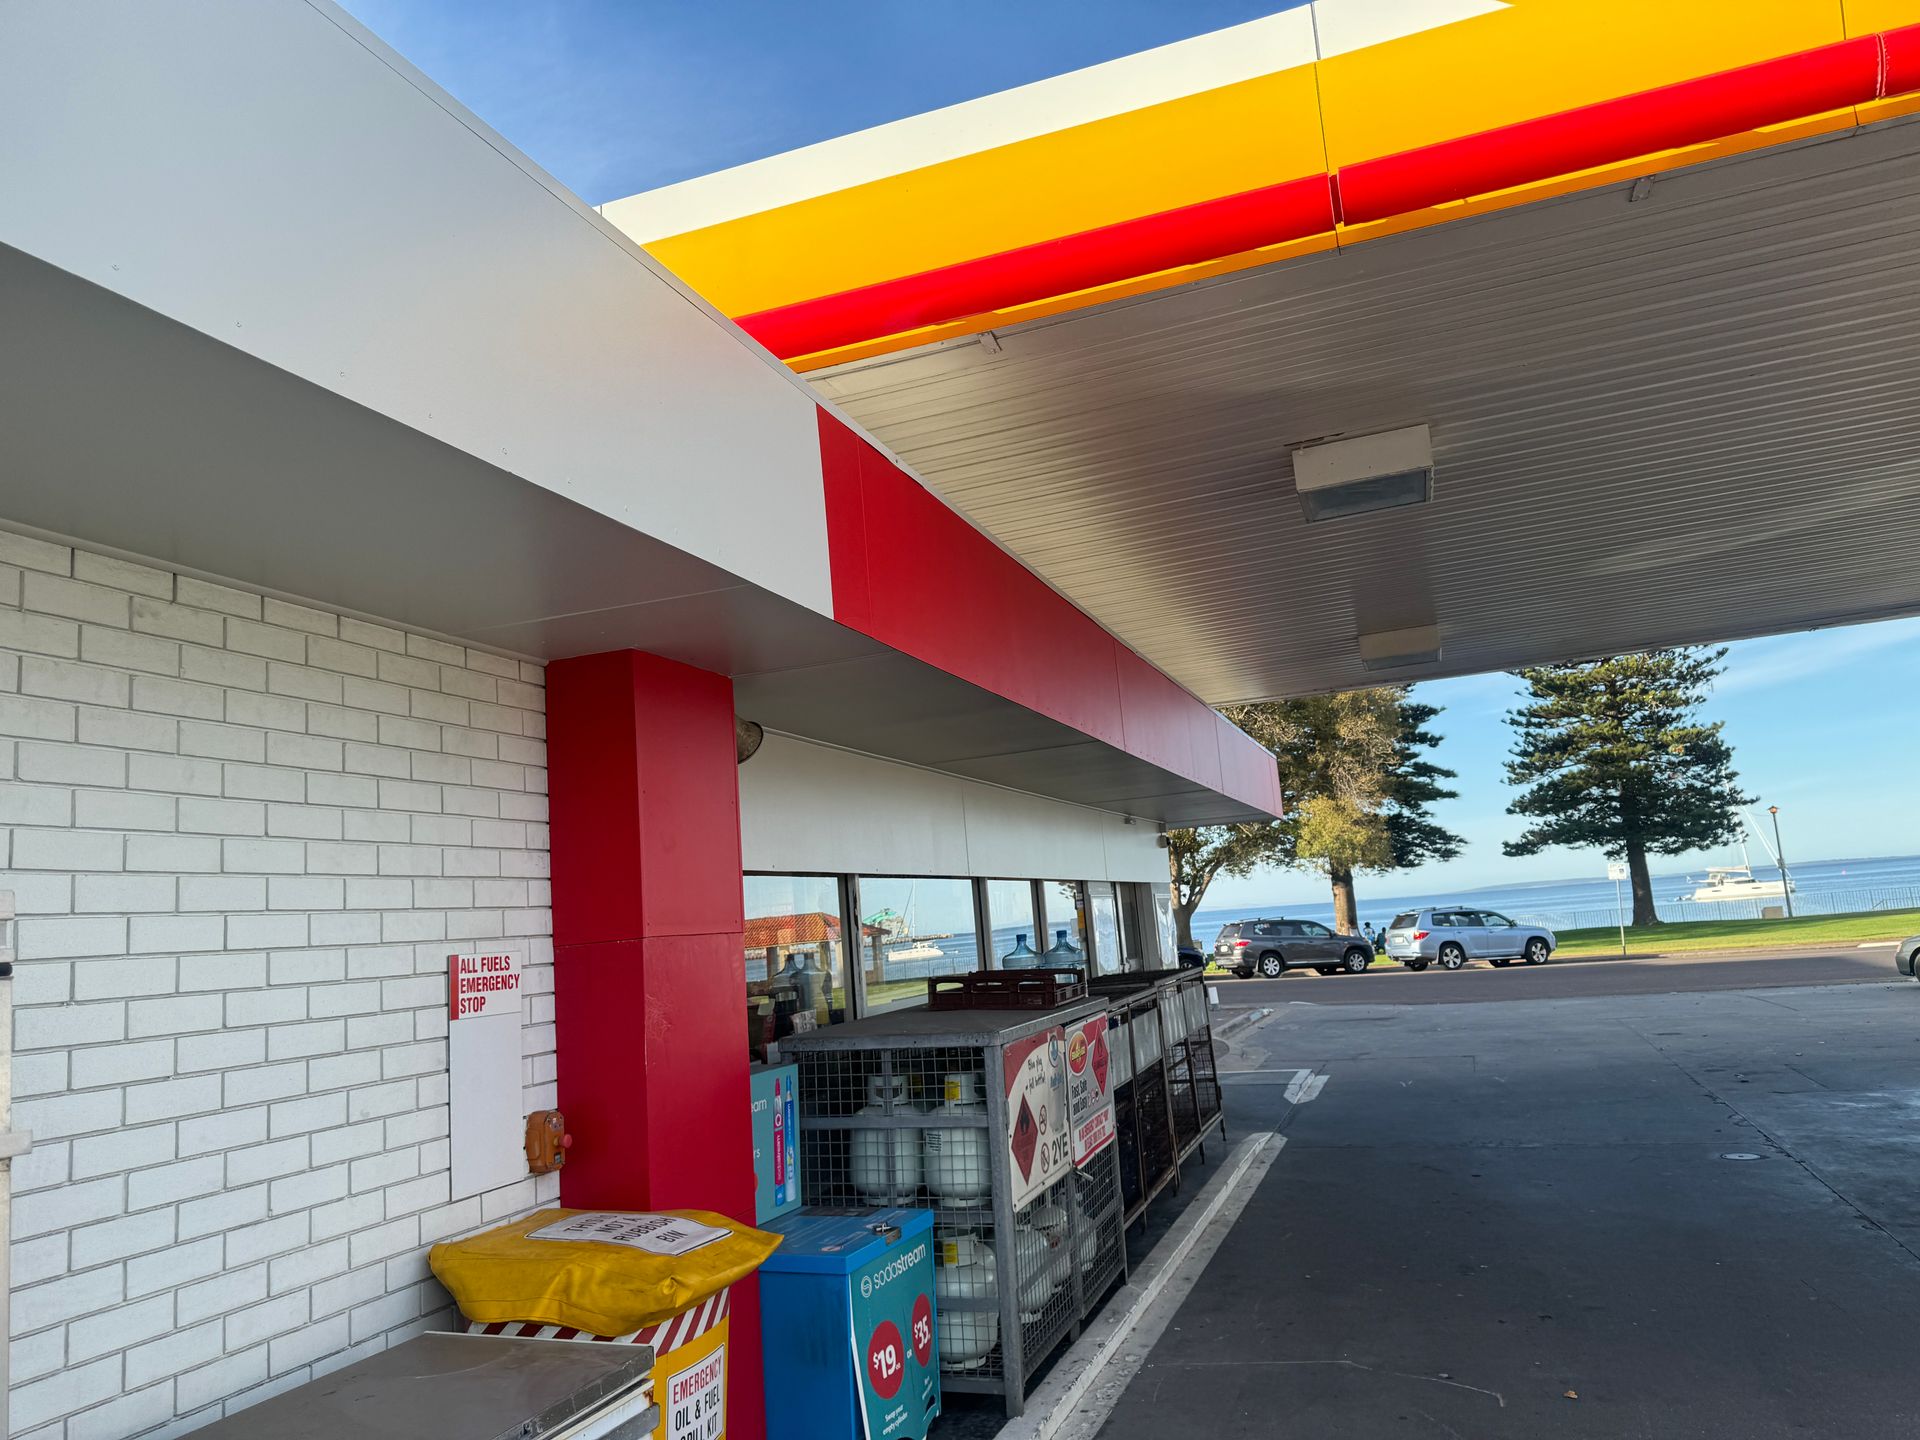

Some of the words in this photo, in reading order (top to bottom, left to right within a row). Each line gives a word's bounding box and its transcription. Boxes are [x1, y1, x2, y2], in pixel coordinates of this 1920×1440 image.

[460, 958, 478, 974] ALL
[481, 955, 510, 972] FUELS
[460, 973, 520, 994] EMERGENCY
[460, 996, 486, 1014] STOP
[1052, 1132, 1069, 1167] 2YE
[564, 1216, 604, 1232] THIS
[594, 1219, 625, 1233] NOT
[612, 1216, 677, 1241] RUBBISH
[655, 1229, 688, 1243] BIN
[873, 1243, 926, 1289] sodastream
[673, 1354, 722, 1405] EMERGENCY
[675, 1406, 691, 1432] OIL
[695, 1399, 701, 1420] &
[705, 1384, 720, 1413] FUEL
[707, 1412, 718, 1439] KIT
